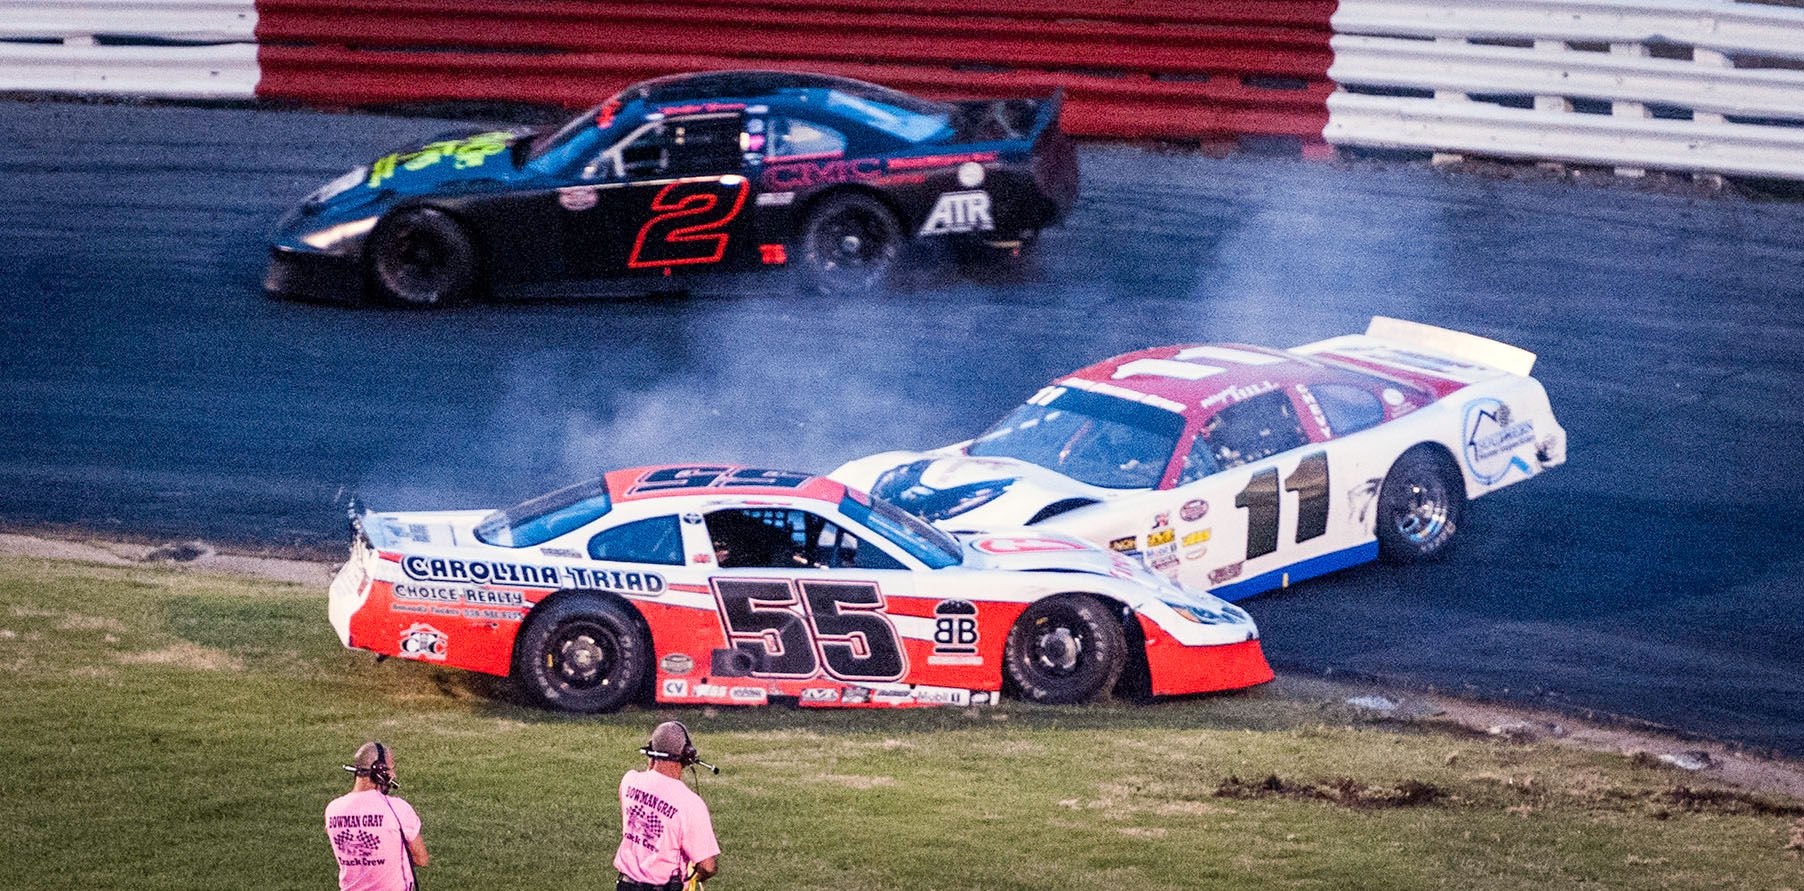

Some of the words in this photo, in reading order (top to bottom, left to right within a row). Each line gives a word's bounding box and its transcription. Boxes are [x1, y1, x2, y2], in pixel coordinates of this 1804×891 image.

[629, 177, 749, 268] 2
[920, 191, 995, 235] ATR
[1235, 450, 1330, 560] 11
[405, 556, 559, 585] CAROLINA
[571, 566, 664, 593] TRIAD
[395, 584, 458, 601] CHOICE
[466, 589, 523, 605] REALTY
[709, 576, 909, 682] 55
[666, 682, 684, 693] CV
[656, 800, 678, 819] GRAY
[362, 814, 384, 827] GRAY
[624, 832, 641, 845] rack
[362, 857, 386, 867] Crew
